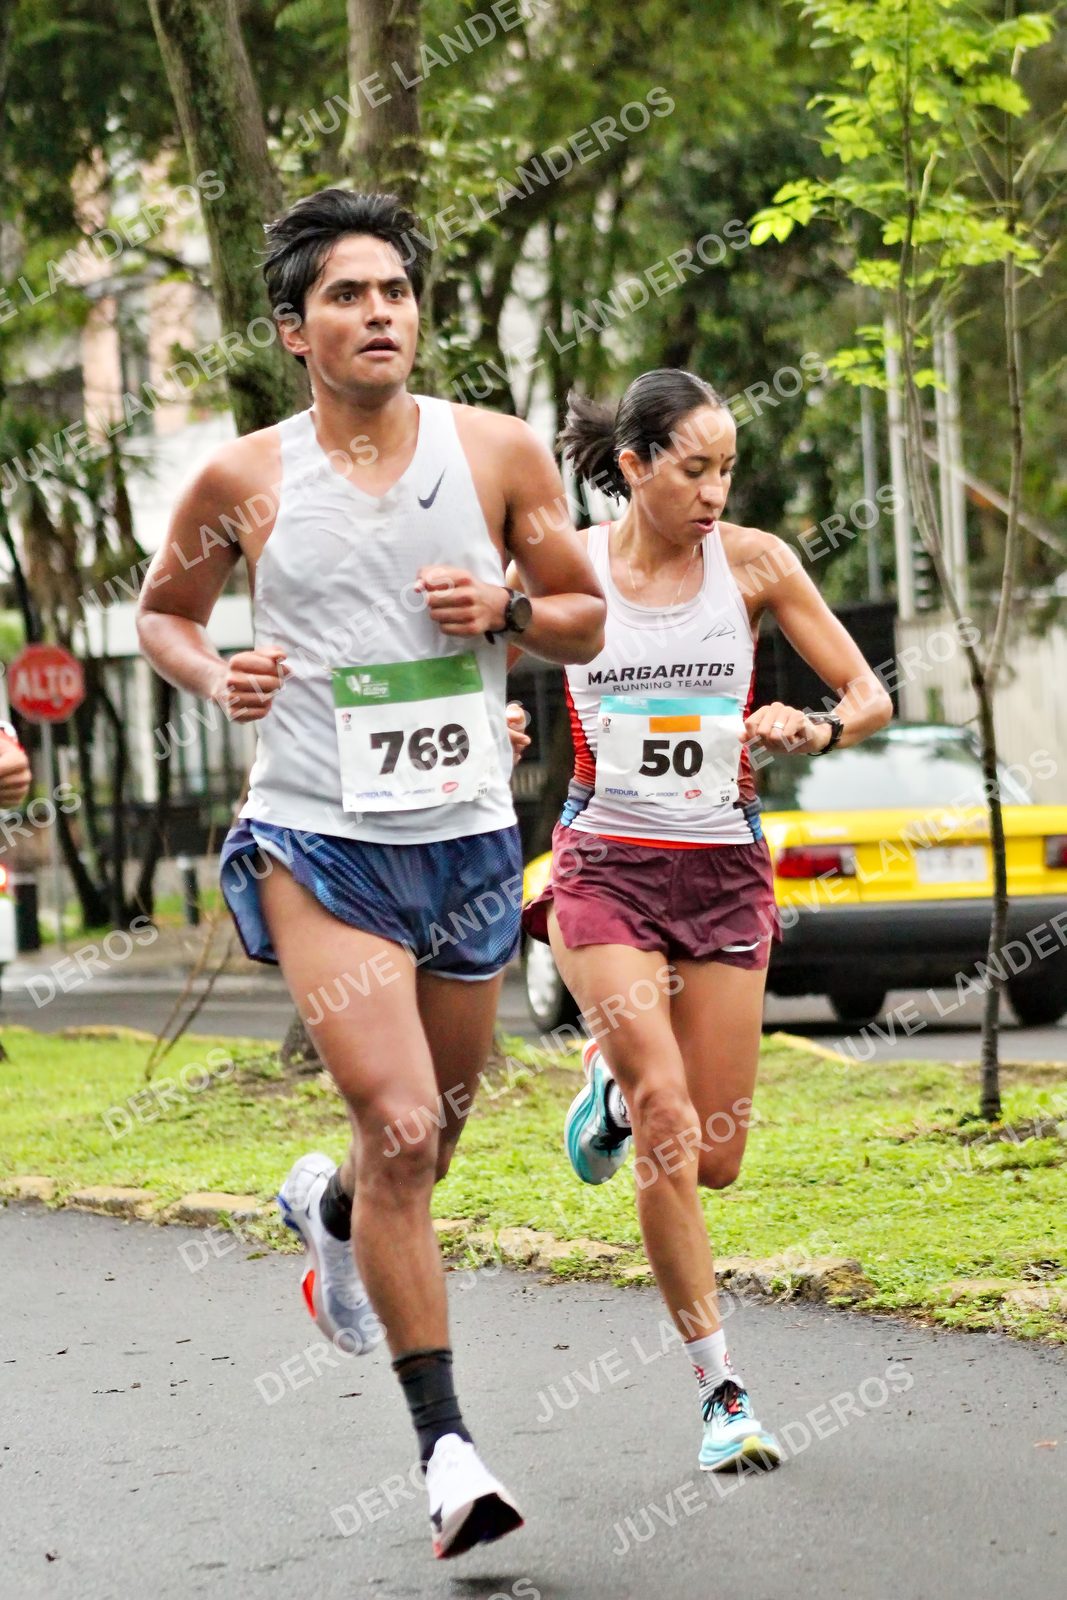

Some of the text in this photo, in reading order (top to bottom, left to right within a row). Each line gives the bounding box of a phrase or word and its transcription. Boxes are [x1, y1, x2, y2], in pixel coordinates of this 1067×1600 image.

[15, 666, 80, 700] ALTO
[588, 663, 734, 685] MARGARITO'S
[613, 679, 712, 692] RUNNING TEAM
[370, 723, 470, 775] 769
[638, 740, 704, 778] 50
[604, 788, 638, 797] PERDURA
